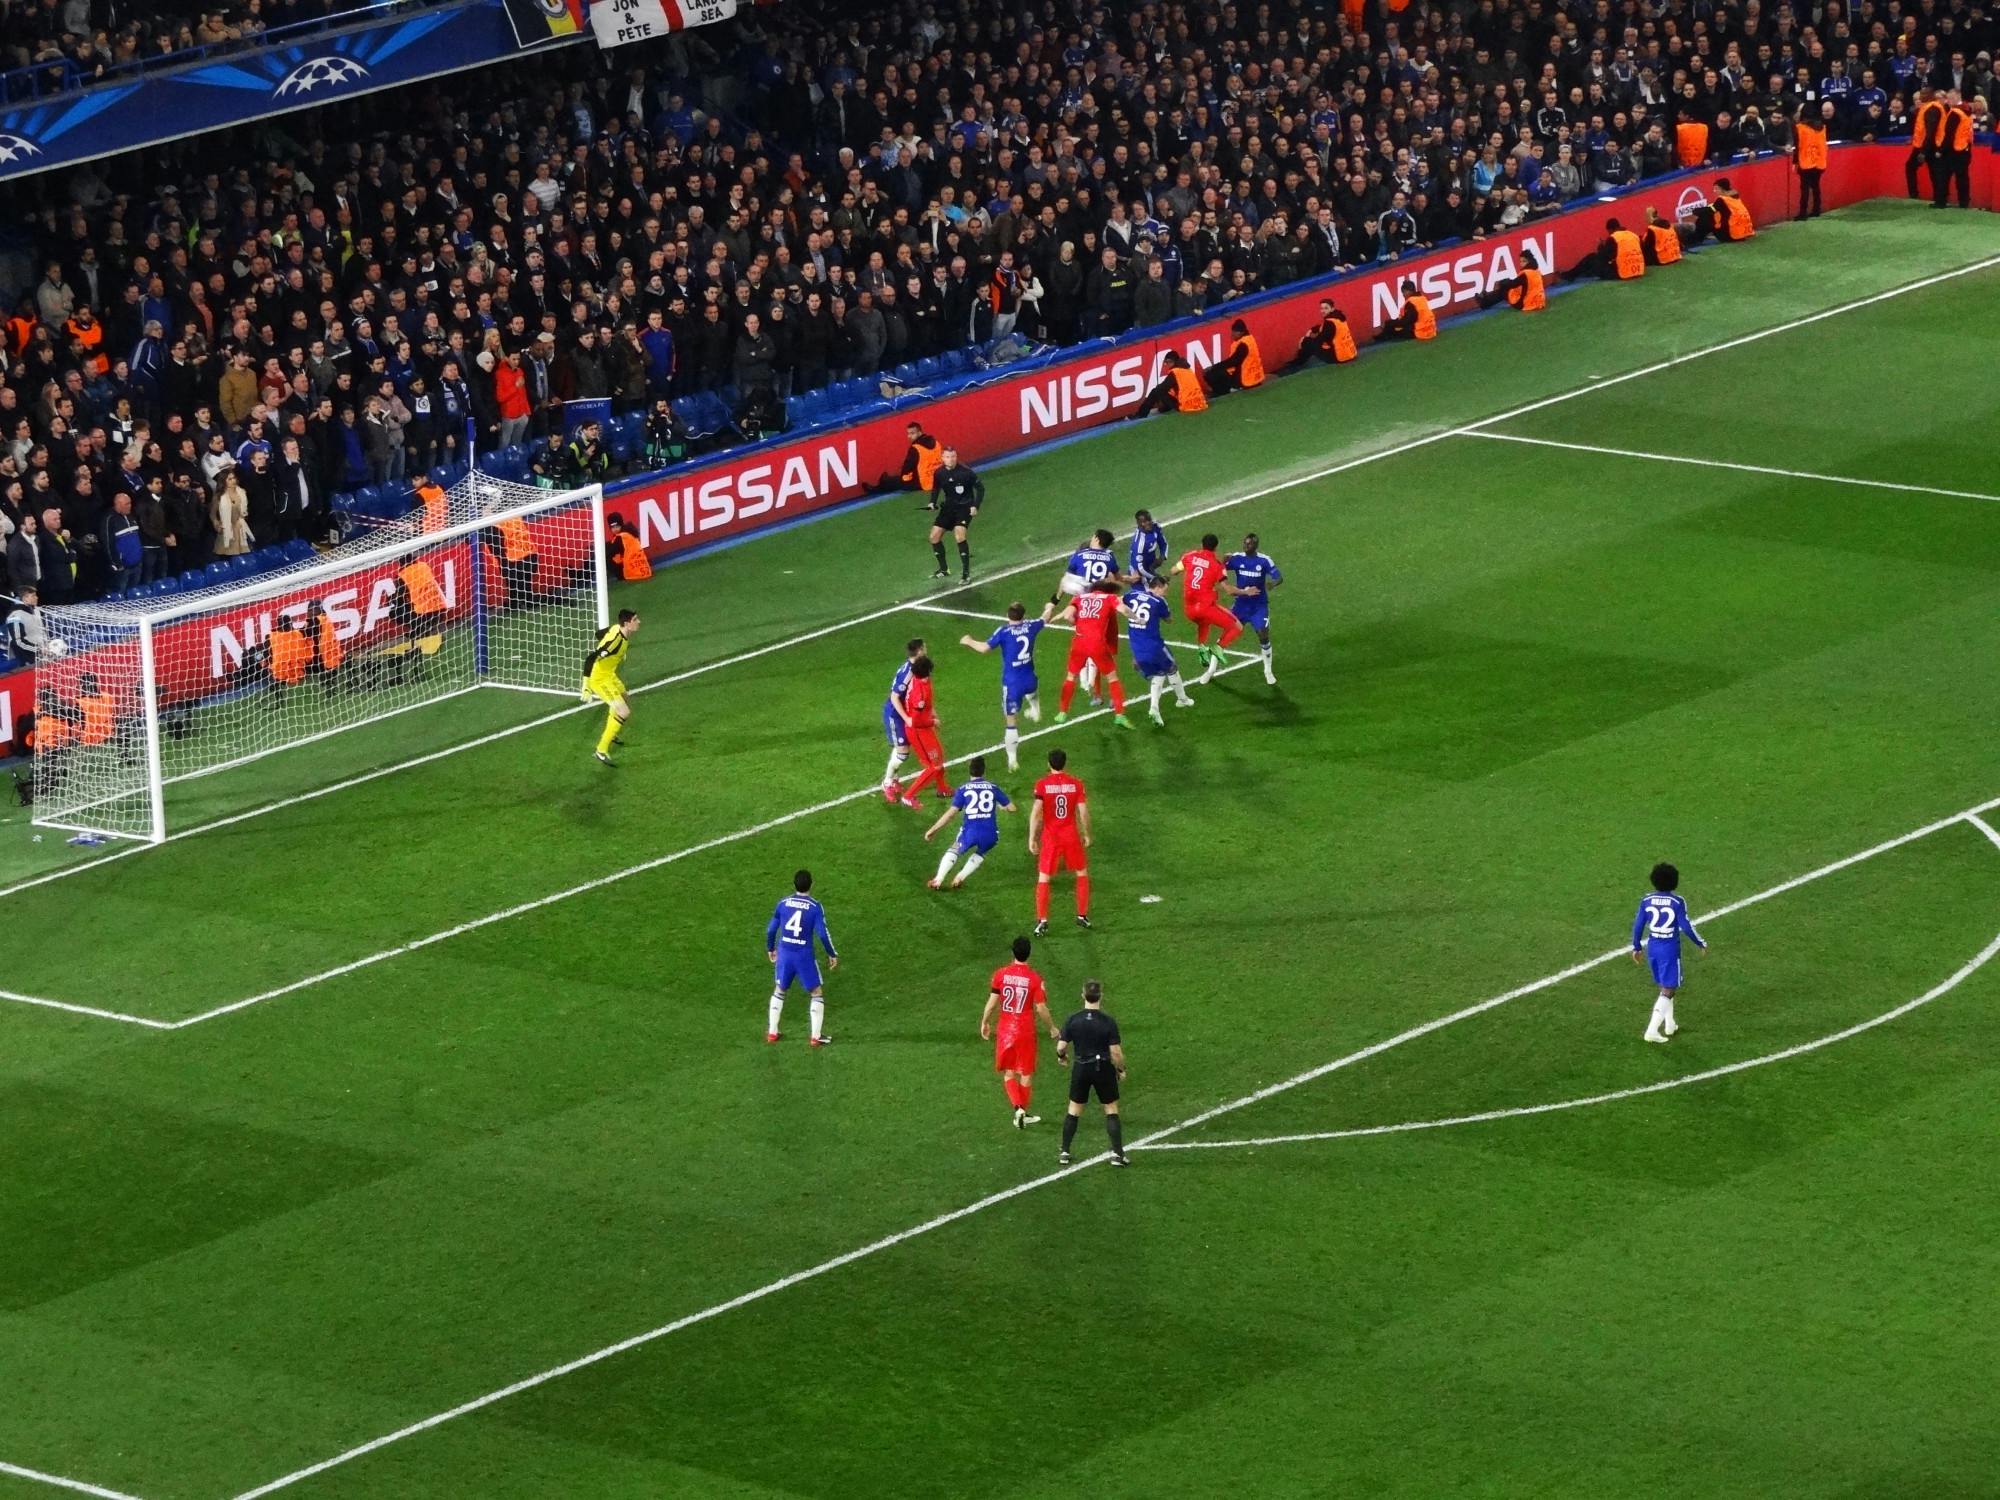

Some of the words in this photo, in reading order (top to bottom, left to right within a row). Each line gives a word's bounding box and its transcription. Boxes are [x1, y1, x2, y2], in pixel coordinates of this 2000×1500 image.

[612, 0, 640, 12] JON
[701, 7, 724, 22] SEA
[624, 12, 636, 25] &
[617, 23, 652, 42] PETE
[638, 440, 858, 549] NISSAN
[1083, 560, 1107, 582] 19
[1191, 566, 1204, 590] 2
[1080, 597, 1103, 619] 32
[1016, 635, 1030, 660] 2
[963, 789, 994, 814] 28
[1055, 794, 1068, 819] 8
[784, 909, 803, 937] 4
[1645, 906, 1675, 933] 22
[1002, 985, 1029, 1013] 27
